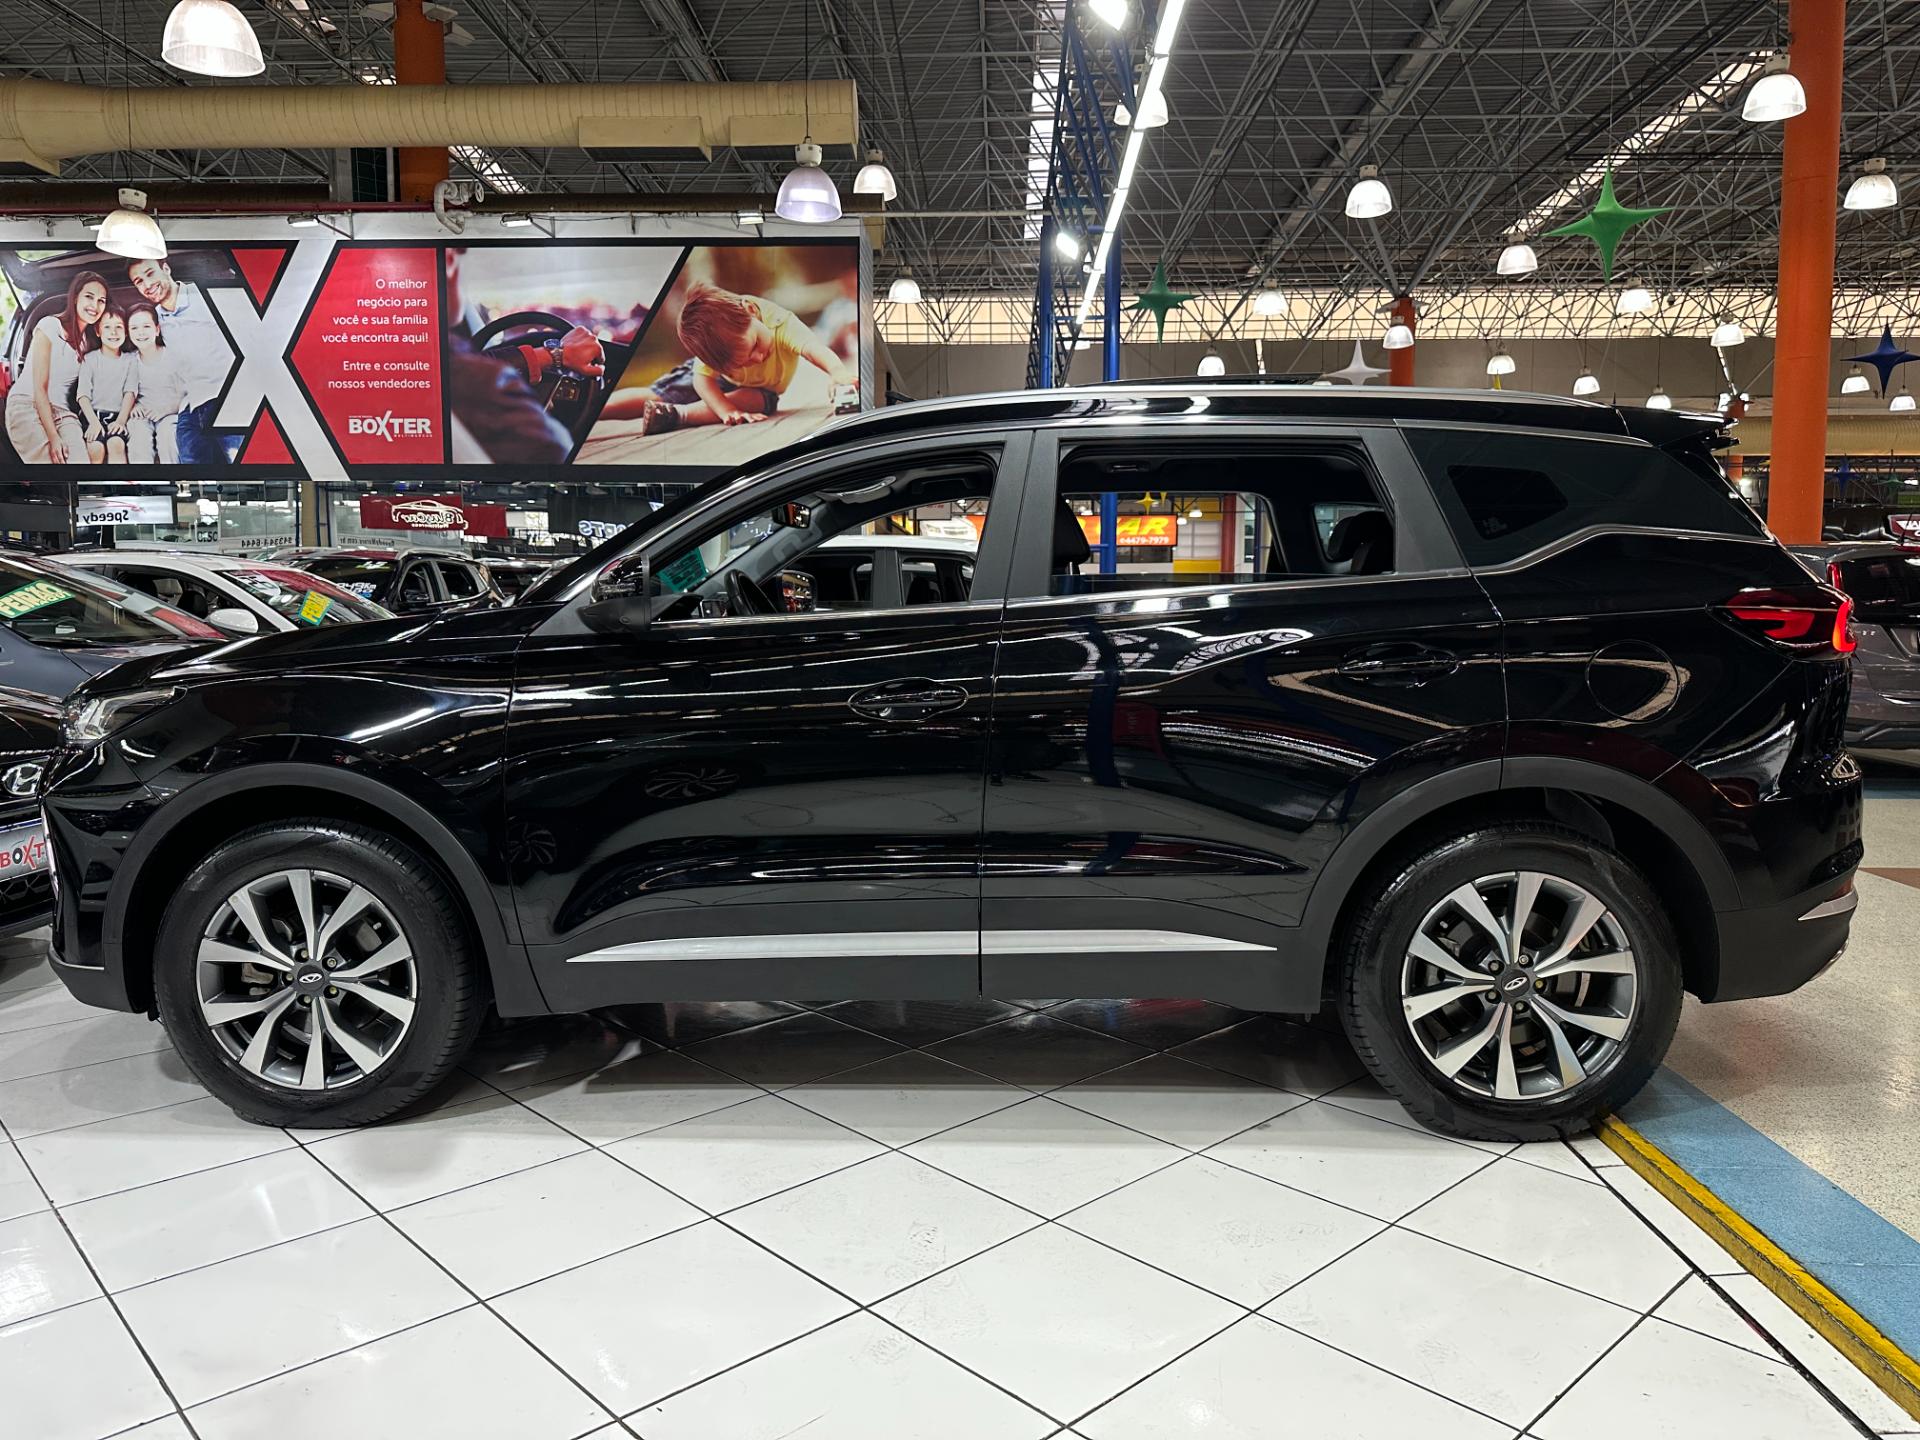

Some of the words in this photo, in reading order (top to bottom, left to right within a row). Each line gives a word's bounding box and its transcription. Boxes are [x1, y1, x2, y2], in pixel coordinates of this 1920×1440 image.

[375, 279, 384, 289] O
[388, 278, 428, 289] melhor
[356, 298, 401, 309] negócio
[404, 299, 428, 309] para
[333, 315, 359, 325] você
[362, 317, 368, 325] e
[371, 317, 389, 325] sua
[392, 315, 428, 325] família
[322, 333, 348, 343] você
[351, 334, 399, 343] encontra
[402, 333, 429, 345] aqui!
[343, 361, 372, 371] Entre
[374, 363, 380, 371] e
[383, 360, 430, 371] consulte
[328, 380, 366, 389] nossos
[368, 378, 431, 389] vendedores
[348, 410, 432, 442] BOXTER
